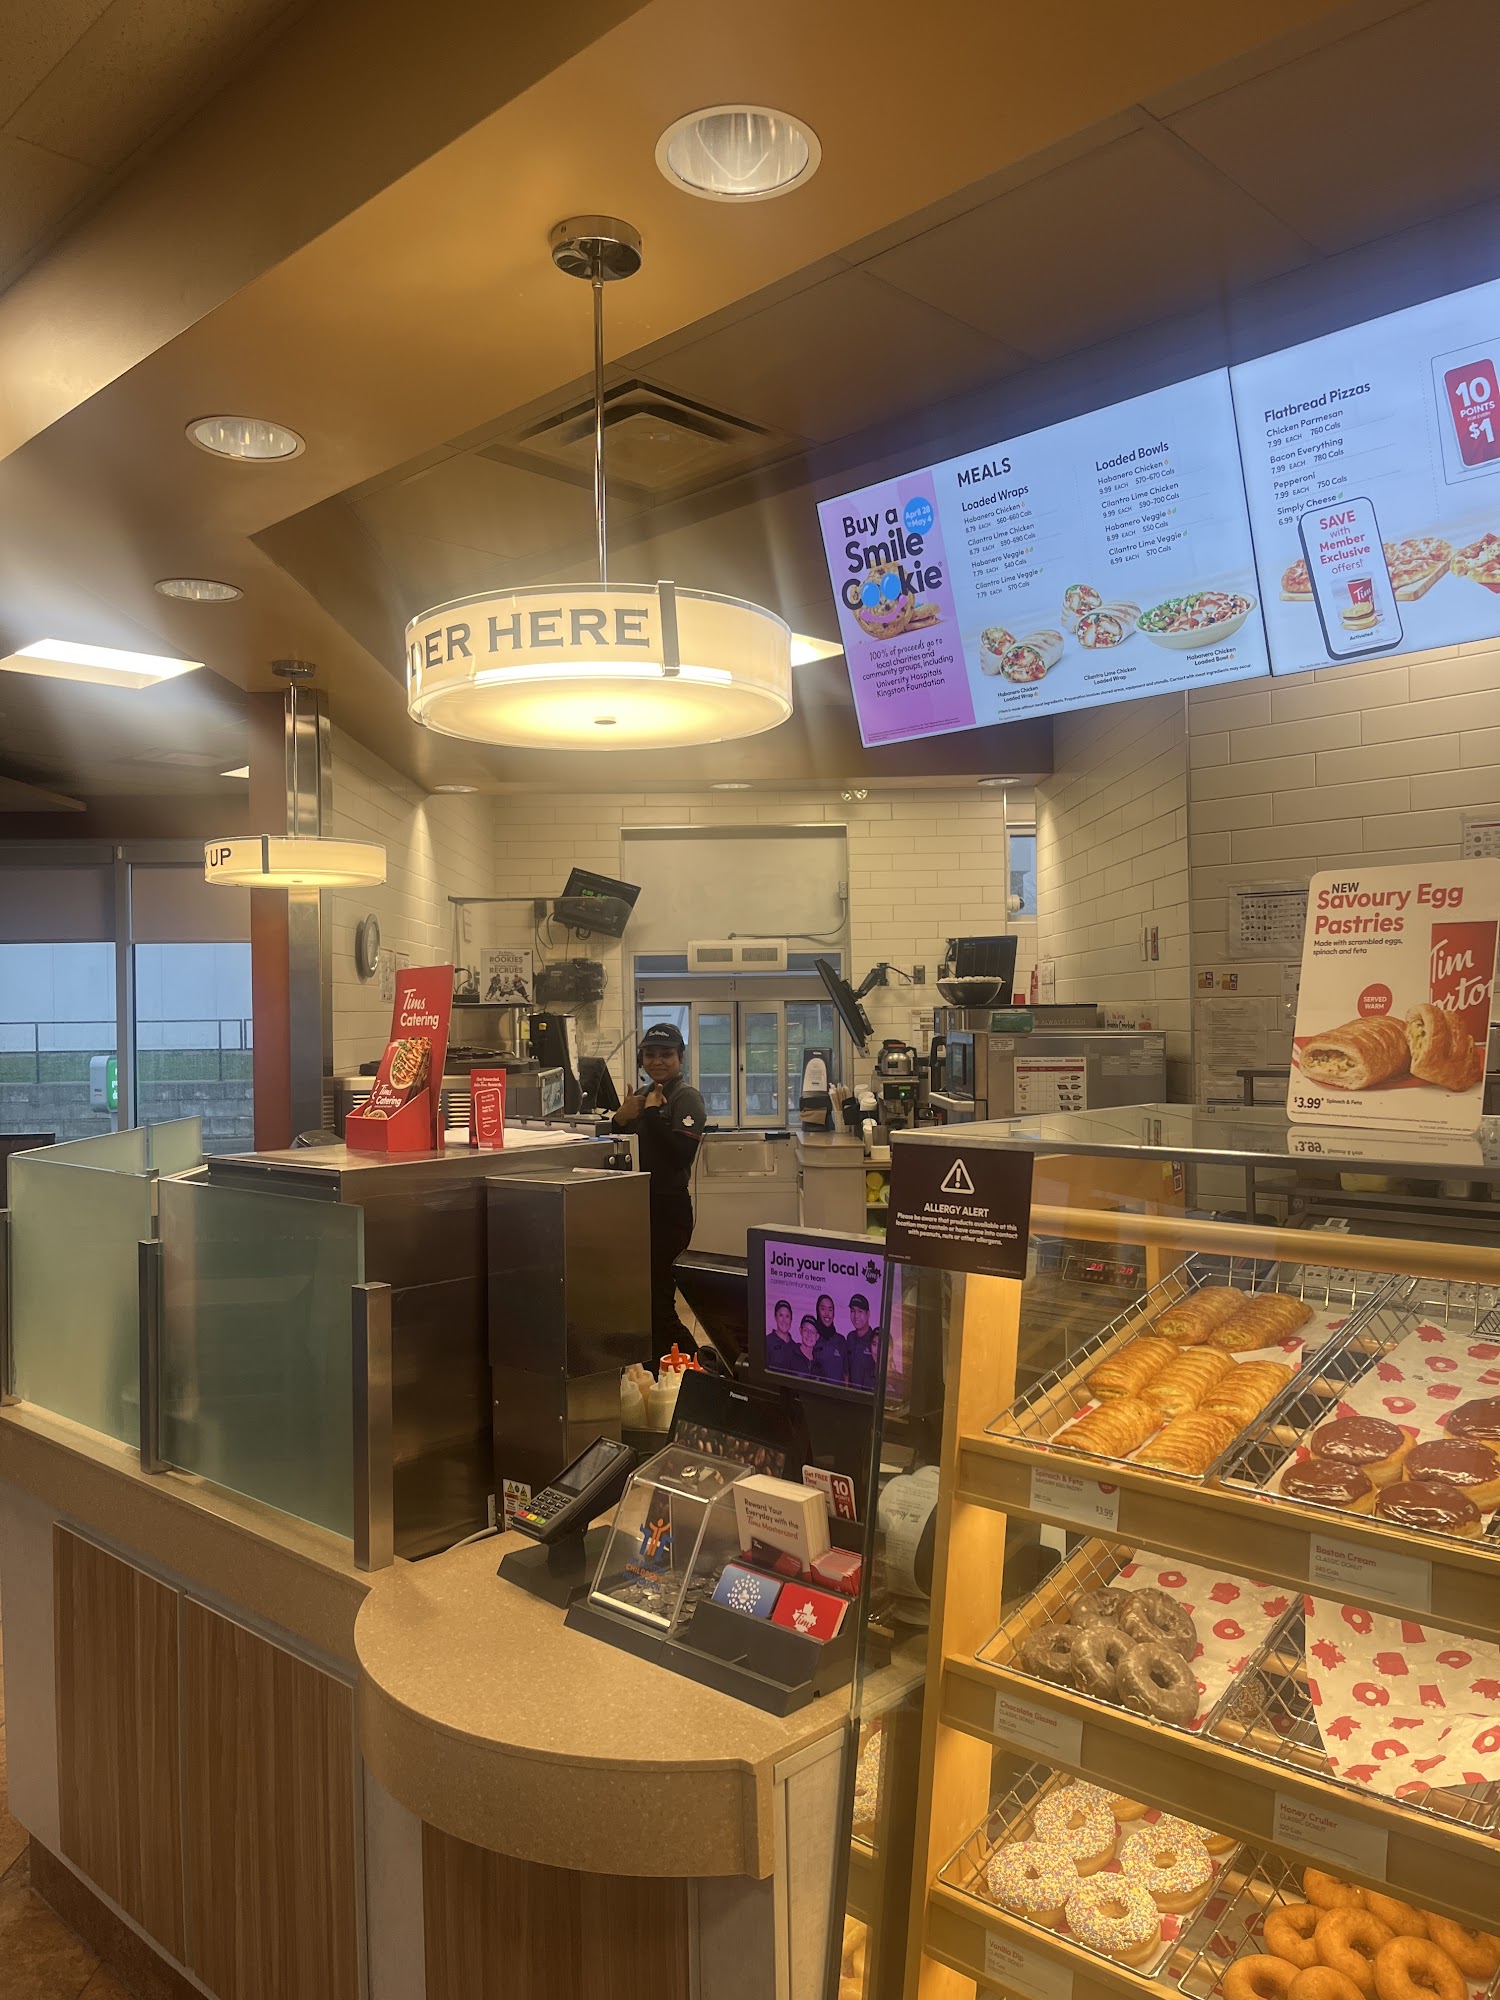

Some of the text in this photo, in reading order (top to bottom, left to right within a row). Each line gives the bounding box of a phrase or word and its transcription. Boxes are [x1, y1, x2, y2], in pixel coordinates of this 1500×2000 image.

[1264, 382, 1371, 423] Flatbread Pizzas
[1455, 376, 1491, 408] 10
[1459, 401, 1496, 418] POINTS
[1266, 409, 1344, 438] Chicken Parmesan
[1468, 417, 1495, 444] $1
[1267, 420, 1341, 449] 7.99 EACH 760 Cals
[1095, 441, 1169, 472] Loaded Bowls
[1270, 436, 1344, 464] Bacon Everything
[1271, 448, 1344, 475] 7.99 EACH 780 Cals
[957, 457, 1012, 488] MEALS
[1098, 461, 1163, 486] Habanero Chicken
[1273, 472, 1316, 491] Pepperoni
[1101, 482, 1179, 509] Cilantro Lime Chicken
[1114, 482, 1129, 491] EACH
[1274, 475, 1348, 501] 7.99 EACH 750 Cals
[961, 485, 1029, 512] Loaded Wraps
[1277, 494, 1337, 517] Simply Cheese
[905, 505, 931, 519] April 28
[963, 502, 1021, 525] Habanero Chicken
[1118, 505, 1132, 515] EACH
[1278, 515, 1293, 526] 6.99
[1319, 510, 1356, 531] SAVE
[842, 508, 898, 538] Buy a
[1105, 511, 1167, 533] Habanero Veggie
[1329, 525, 1351, 539] with
[967, 523, 1035, 546] Cilantro Lime Chicken
[1108, 531, 1182, 556] Cilantro Lime Veggie
[1121, 530, 1136, 538] EACH
[1319, 533, 1365, 553] Member
[845, 527, 924, 573] Smile
[971, 549, 1025, 568] Habanero Veggie
[1319, 545, 1371, 566] Exclusive
[975, 568, 1039, 590] Cilantro Lime Veggie
[487, 607, 651, 653] HERE
[869, 640, 925, 662] 100% of proceeds
[876, 649, 935, 669] local charities and
[1186, 647, 1236, 661] Habanero Chicken
[862, 655, 954, 681] community groups, including
[876, 668, 942, 690] University Hospitals
[876, 677, 946, 698] Kingston Foundation
[210, 847, 232, 867] UP
[1317, 883, 1464, 911] Savoury Egg
[1331, 882, 1359, 894] NEW
[1315, 912, 1405, 935] Pastries
[1313, 948, 1338, 956] spinach
[1314, 938, 1403, 947] Made with scrambled eggs,
[1430, 939, 1475, 984] Tim
[403, 988, 426, 1010] Tims
[400, 1011, 440, 1030] Catering
[379, 1084, 393, 1096] Tims
[375, 1096, 402, 1108] Catering
[896, 1212, 913, 1221] Please
[950, 1217, 973, 1228] products
[973, 1221, 999, 1230] available
[924, 1203, 990, 1218] ALLERGY ALERT
[896, 1219, 1018, 1240] location contain contact
[770, 1250, 859, 1276] Join your local
[770, 1268, 826, 1283] Be part of team
[815, 1472, 828, 1482] FREE
[1035, 1469, 1084, 1486] Spinach Feta
[833, 1480, 849, 1496] 10
[744, 1498, 782, 1516] Reward Your
[838, 1503, 850, 1519] $1
[1096, 1506, 1113, 1517] $3.99
[745, 1507, 799, 1529] Everyday with the
[762, 1522, 798, 1540] Mastercard
[1316, 1545, 1377, 1567] Boston Cream
[1316, 1555, 1362, 1571] CLASSIC DONUT
[797, 1611, 814, 1628] Tims
[1000, 1700, 1057, 1727] Chocolate Glazed
[1280, 1803, 1338, 1828] Honey Cruller
[1280, 1814, 1326, 1832] CLASSIC DONUT
[989, 1940, 1024, 1962] Vanilla Dip
